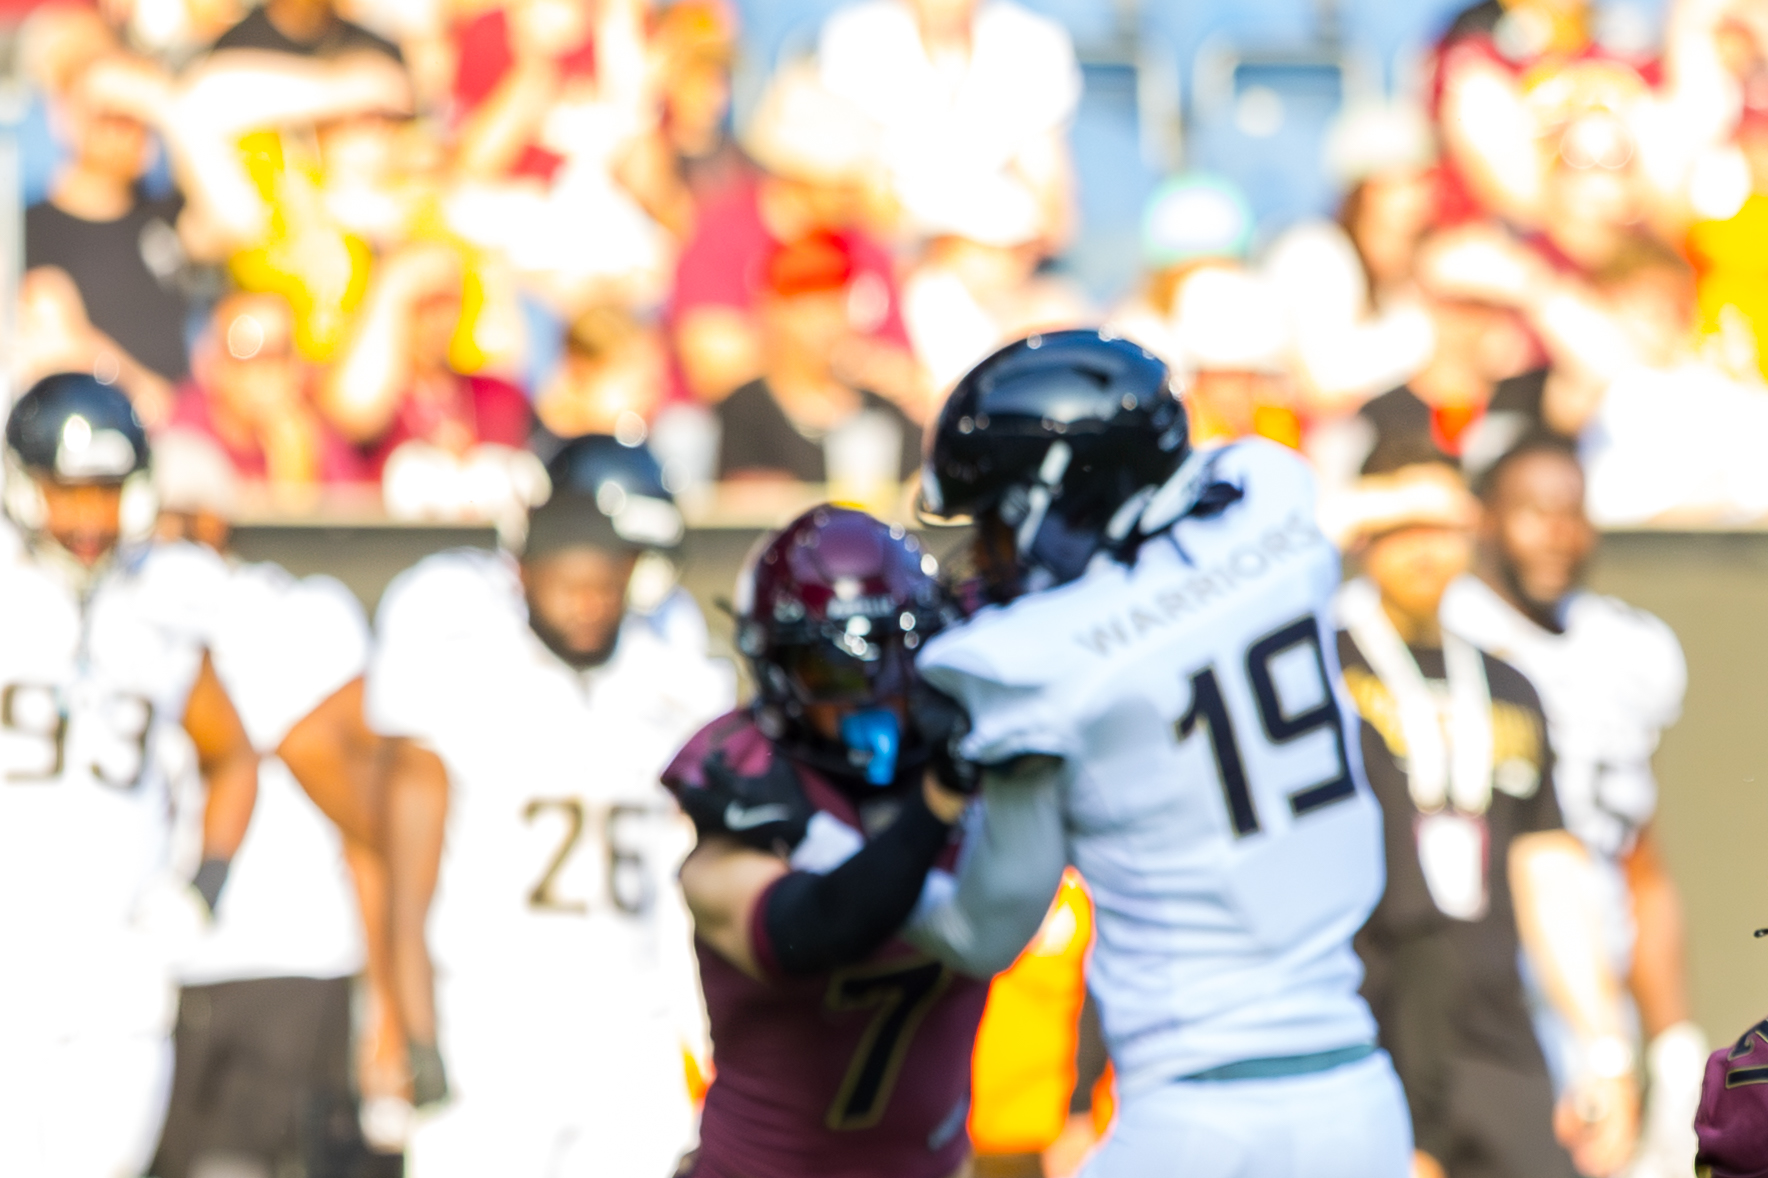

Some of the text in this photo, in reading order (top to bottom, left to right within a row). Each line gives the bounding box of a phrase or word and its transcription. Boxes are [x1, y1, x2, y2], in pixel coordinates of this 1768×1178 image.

[0, 682, 156, 792] 93
[1172, 610, 1362, 838] 19
[519, 796, 662, 918] 26
[828, 956, 952, 1130] 7
